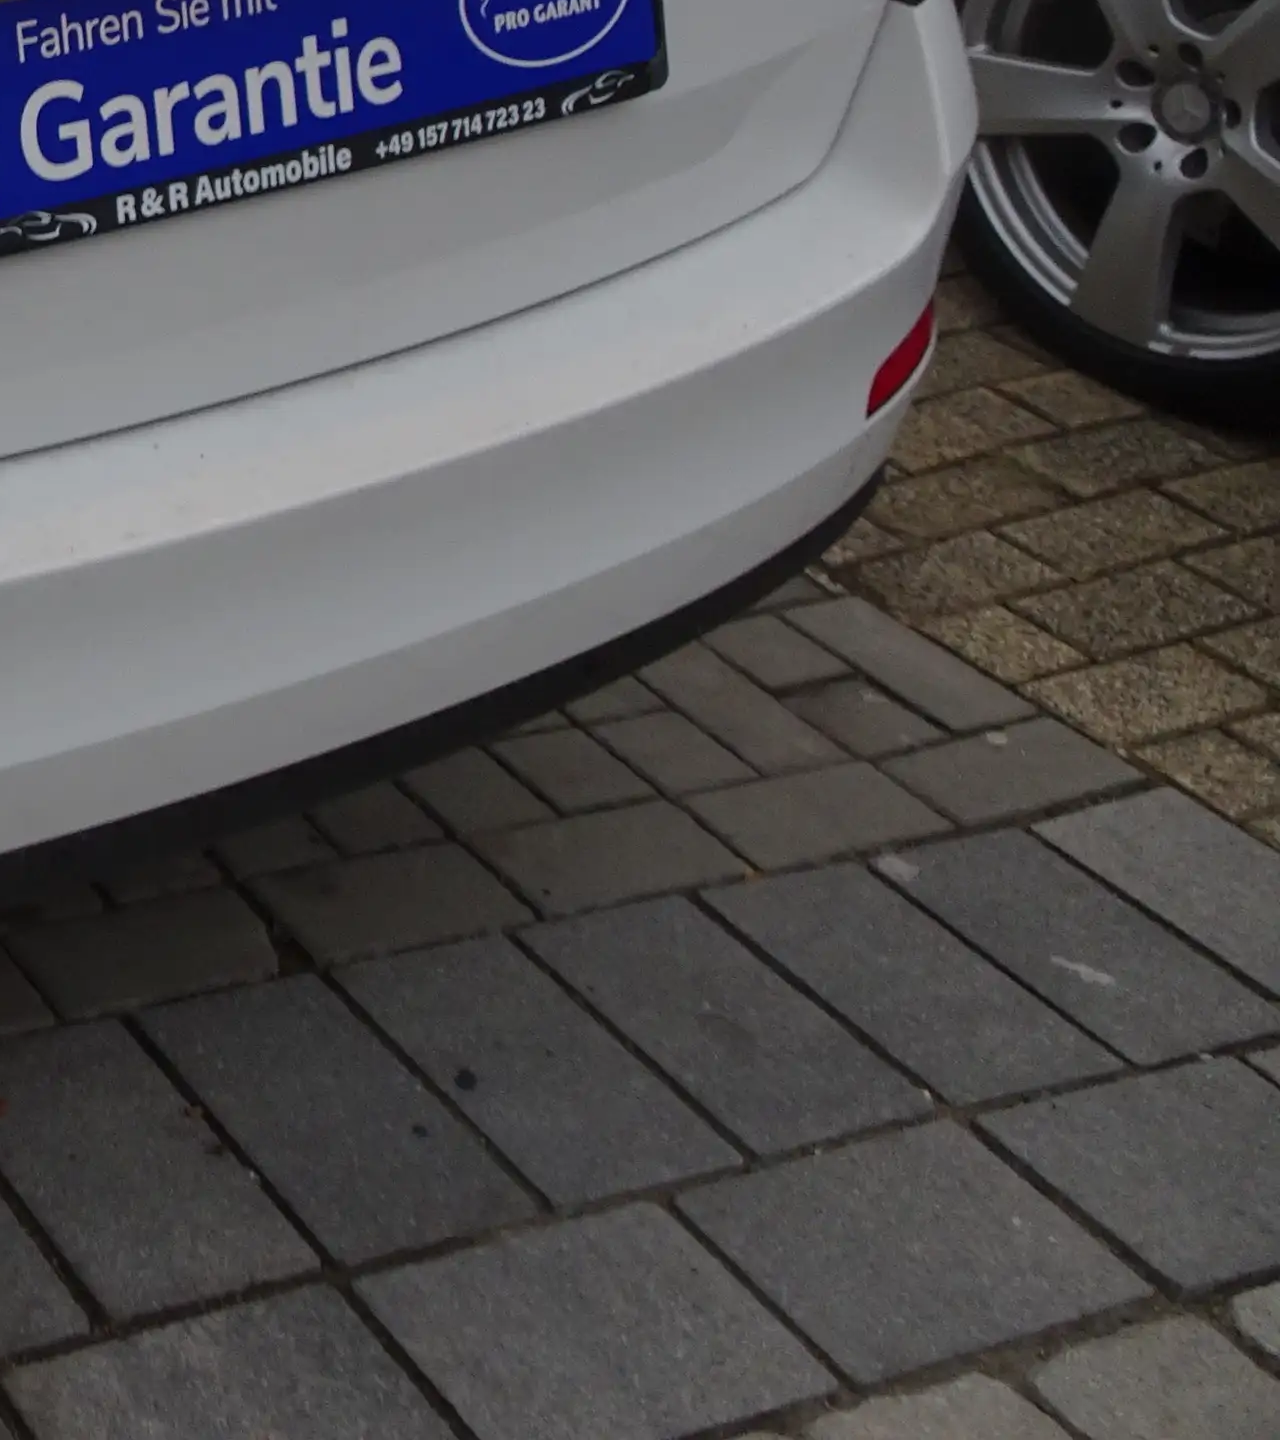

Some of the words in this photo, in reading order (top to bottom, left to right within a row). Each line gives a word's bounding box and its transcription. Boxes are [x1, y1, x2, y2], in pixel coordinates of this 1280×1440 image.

[16, 9, 143, 64] Fahren
[494, 9, 530, 34] PRO
[19, 17, 404, 182] Garantie
[375, 131, 414, 159] +49
[417, 121, 448, 149] 157
[451, 113, 483, 141] 714
[485, 104, 520, 131] 723
[522, 96, 547, 122] 23
[116, 194, 137, 224] R
[141, 187, 166, 218] &
[168, 181, 189, 212] R
[194, 143, 353, 206] Automobile
